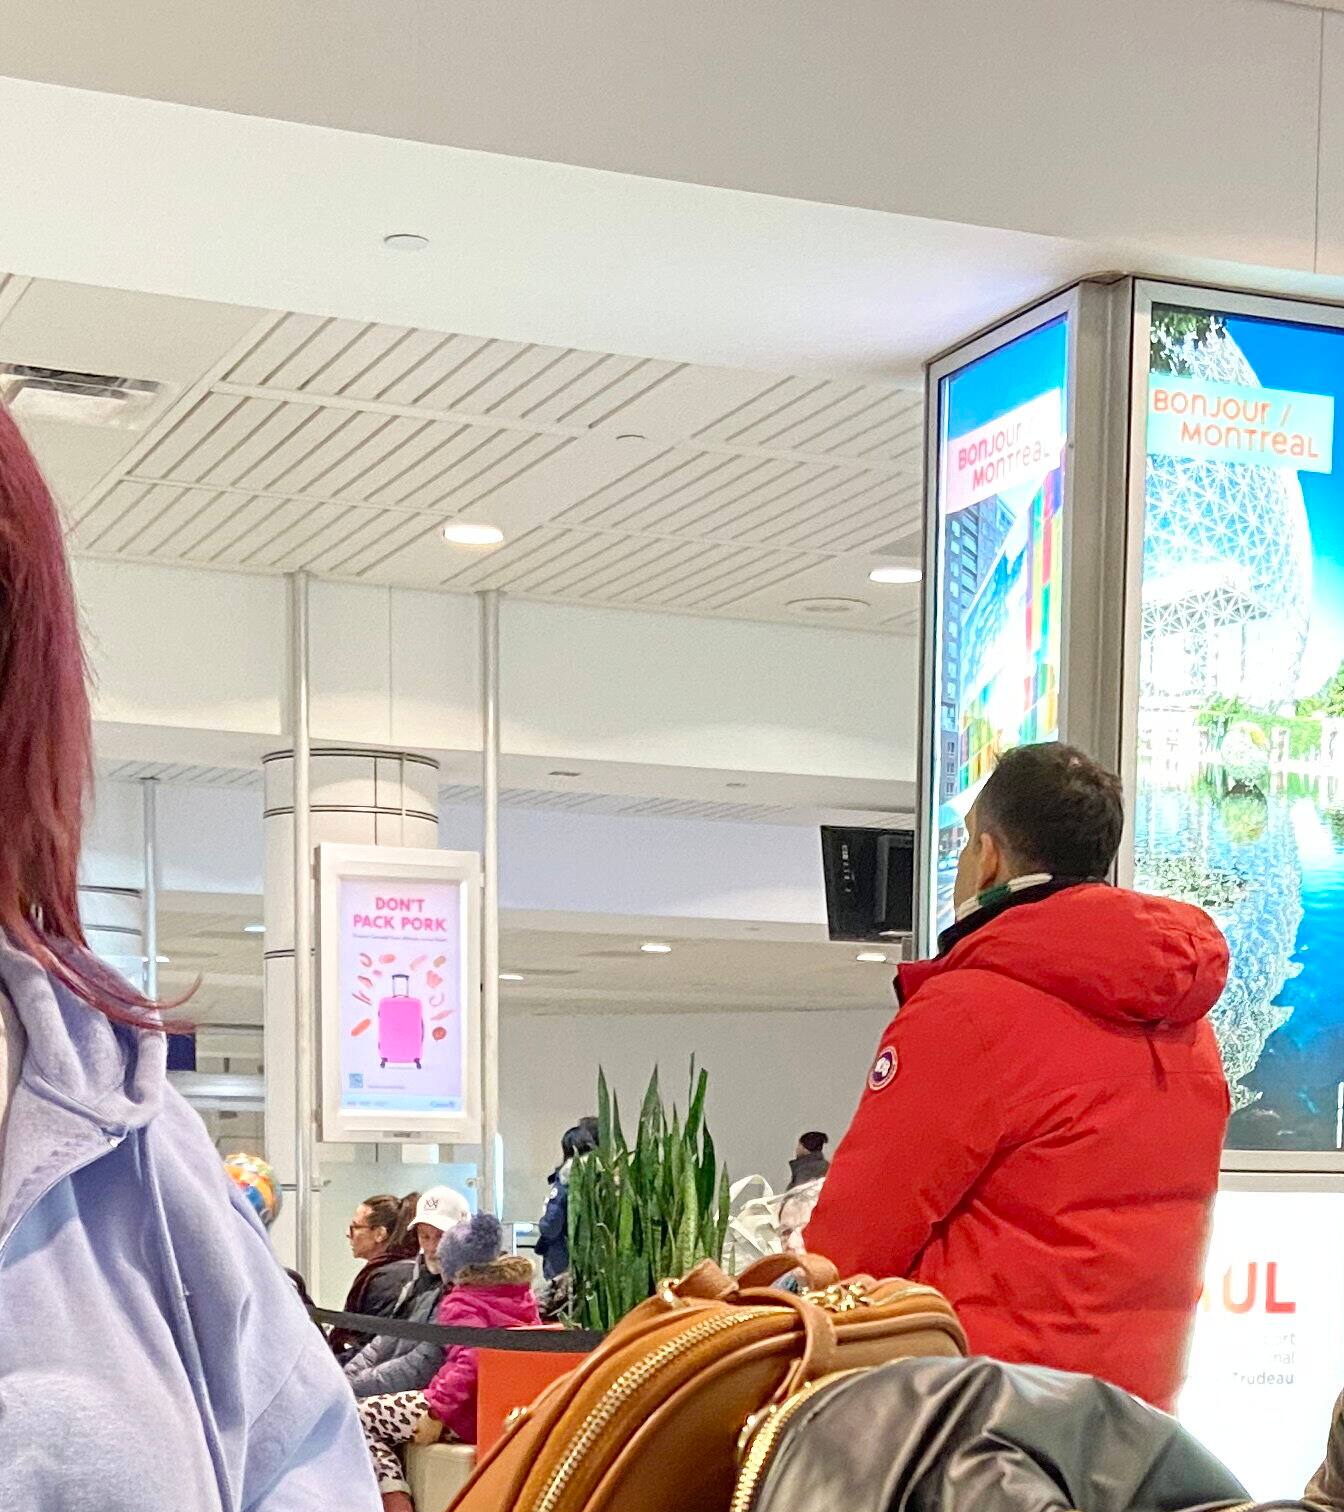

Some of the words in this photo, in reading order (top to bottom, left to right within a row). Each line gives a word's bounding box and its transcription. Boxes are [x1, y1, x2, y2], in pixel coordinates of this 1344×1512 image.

[375, 897, 425, 912] DON'T
[353, 914, 395, 930] PACK
[401, 917, 447, 932] PORK
